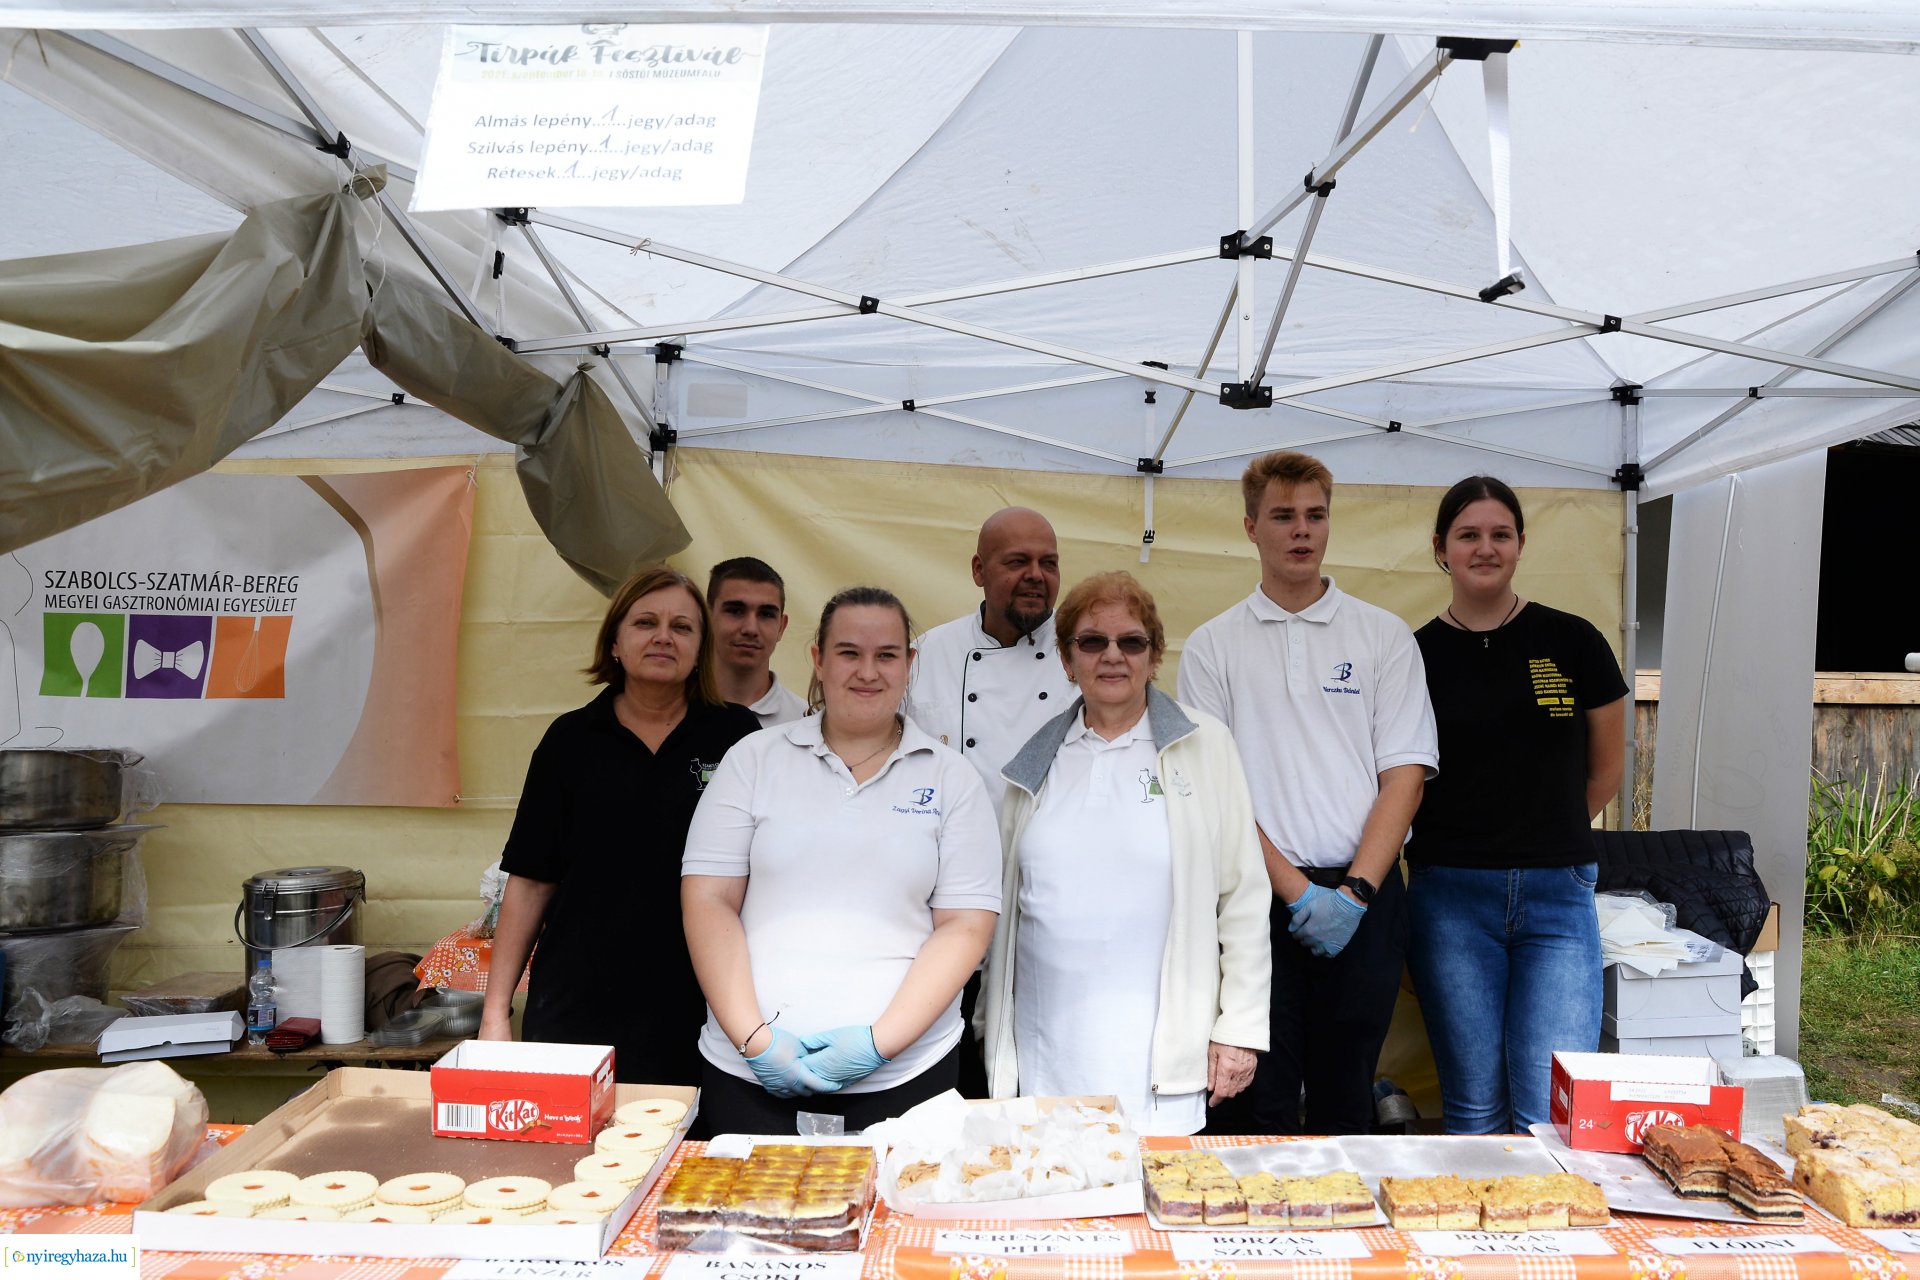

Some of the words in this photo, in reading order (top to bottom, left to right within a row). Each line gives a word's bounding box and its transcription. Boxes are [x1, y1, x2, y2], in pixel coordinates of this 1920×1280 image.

[455, 41, 579, 65] Tirpák
[587, 40, 760, 67] Fesztivál
[474, 115, 528, 128] Almás
[467, 140, 525, 154] Szilvás
[44, 570, 299, 594] SZABOLCS-SZATMÁR-BEREG
[44, 594, 99, 609] MEGYEI
[103, 594, 220, 612] GASZTRONÓMIAI
[223, 597, 297, 612] EGYESÜLET
[494, 1100, 536, 1130] KitKat
[1578, 1119, 1594, 1130] 24
[1473, 1244, 1561, 1253] ALMÁS
[1691, 1239, 1797, 1249] FLÓDNI
[1214, 1246, 1323, 1256] SZILVÁS
